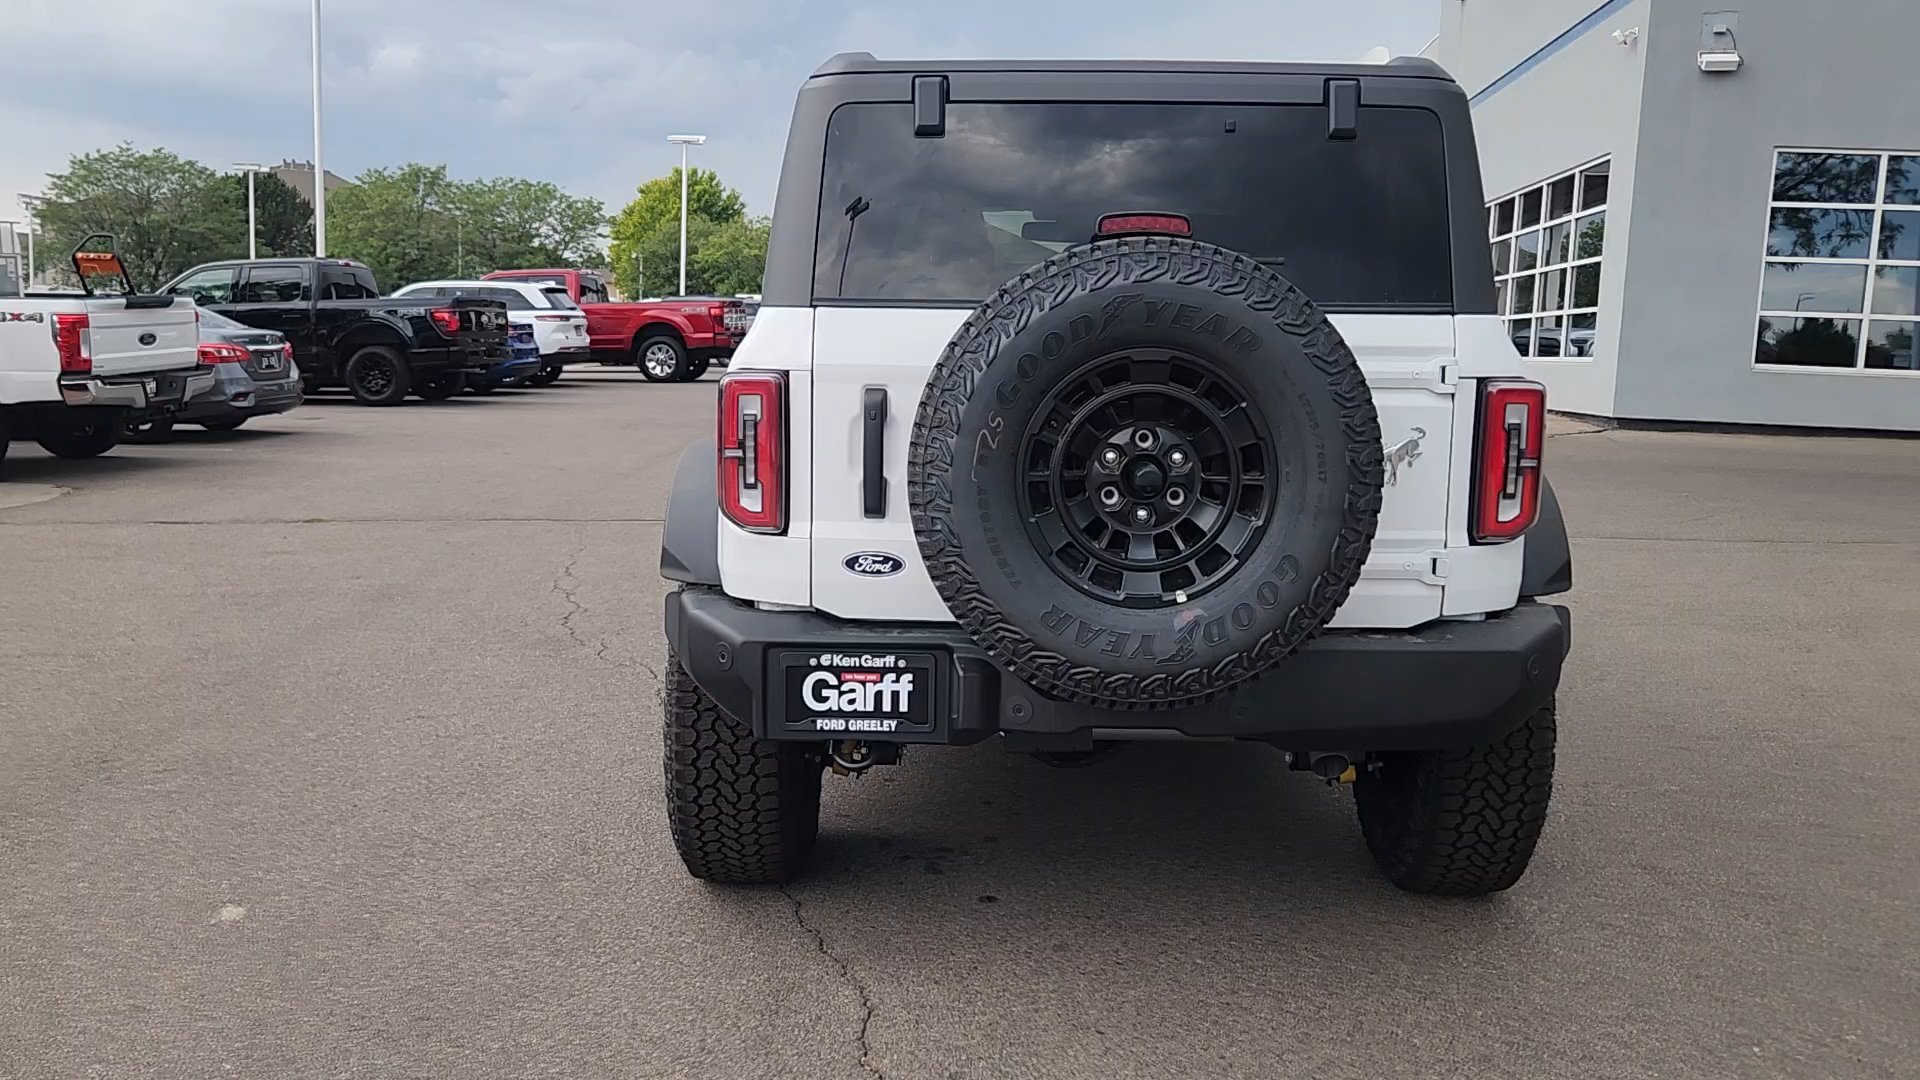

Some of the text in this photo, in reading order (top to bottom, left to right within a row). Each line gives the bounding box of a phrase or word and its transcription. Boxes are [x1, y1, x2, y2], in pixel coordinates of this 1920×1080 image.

[854, 555, 893, 573] Ford
[833, 654, 896, 668] Ken Garff
[802, 671, 914, 713] Garff
[816, 719, 898, 732] FORD GREELEY
